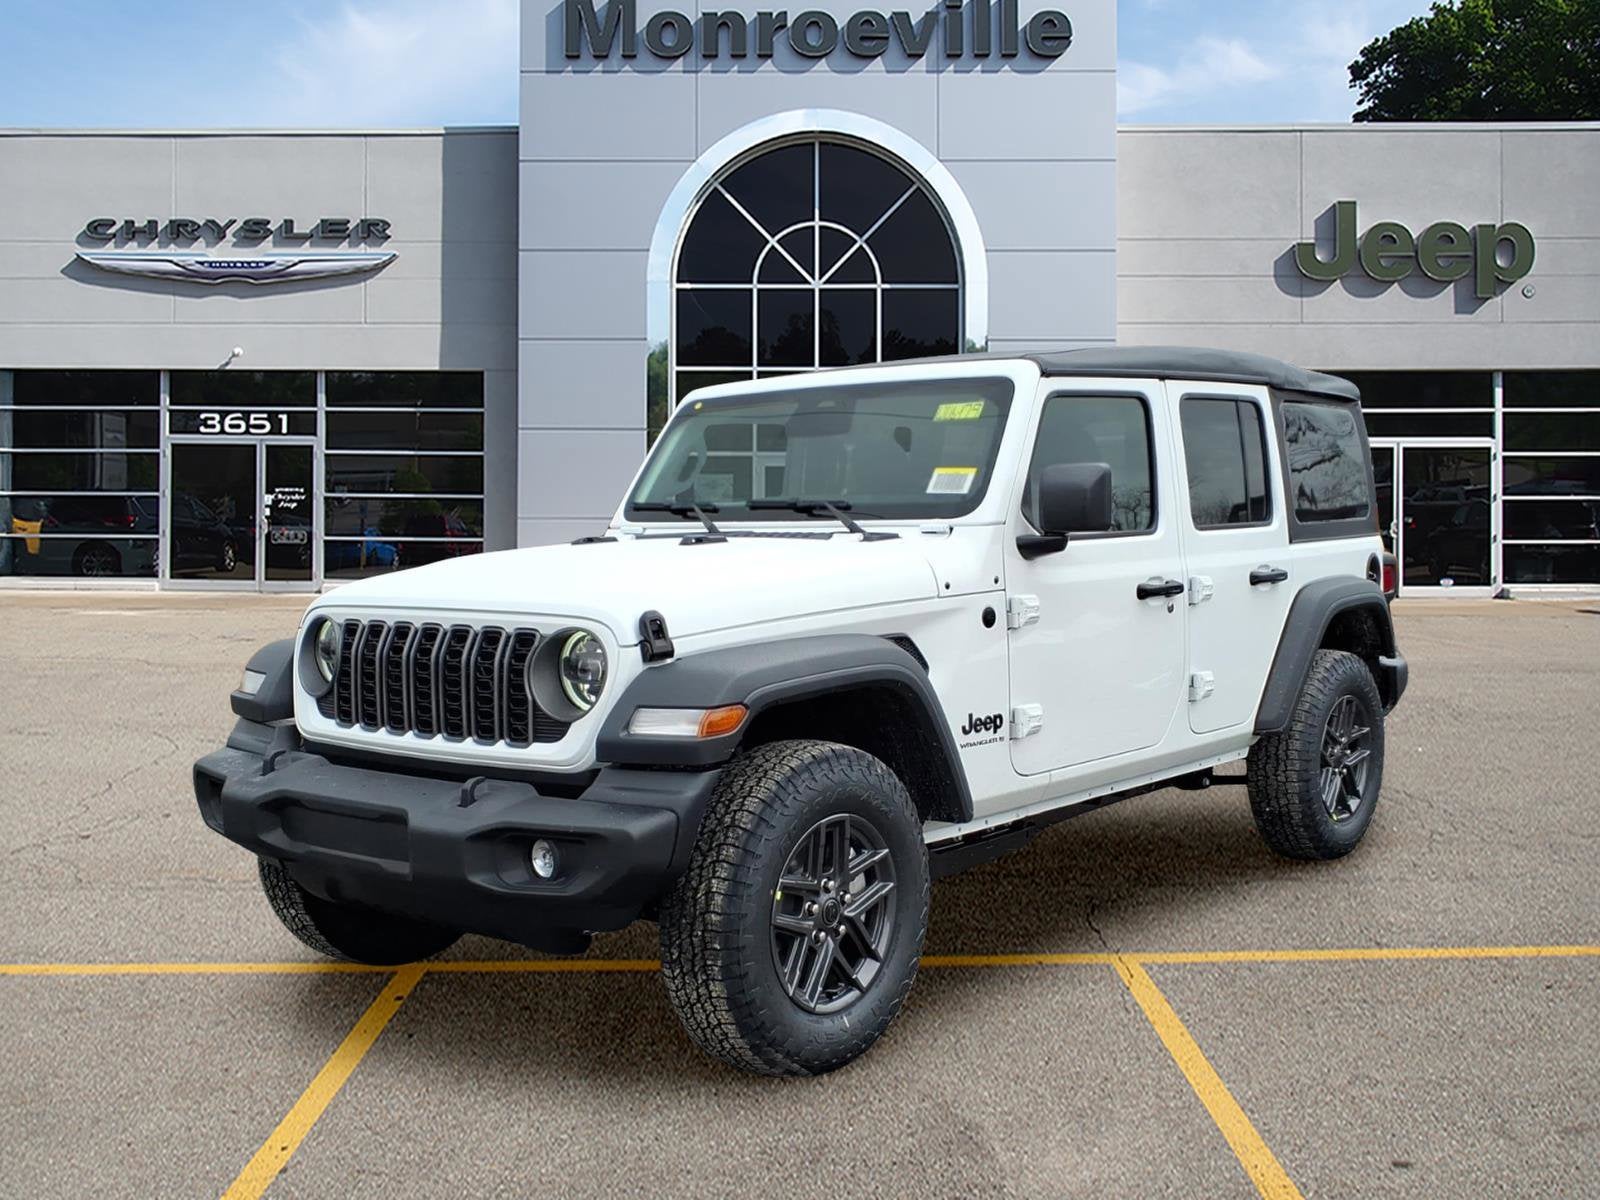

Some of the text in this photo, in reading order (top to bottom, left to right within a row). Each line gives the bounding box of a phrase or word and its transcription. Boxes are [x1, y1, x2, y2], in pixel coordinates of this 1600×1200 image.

[564, 0, 1074, 58] Monroeville
[85, 218, 392, 240] CHRYSLER
[1295, 200, 1535, 299] Jeep
[199, 413, 288, 434] 3651
[961, 713, 1003, 735] Jeep
